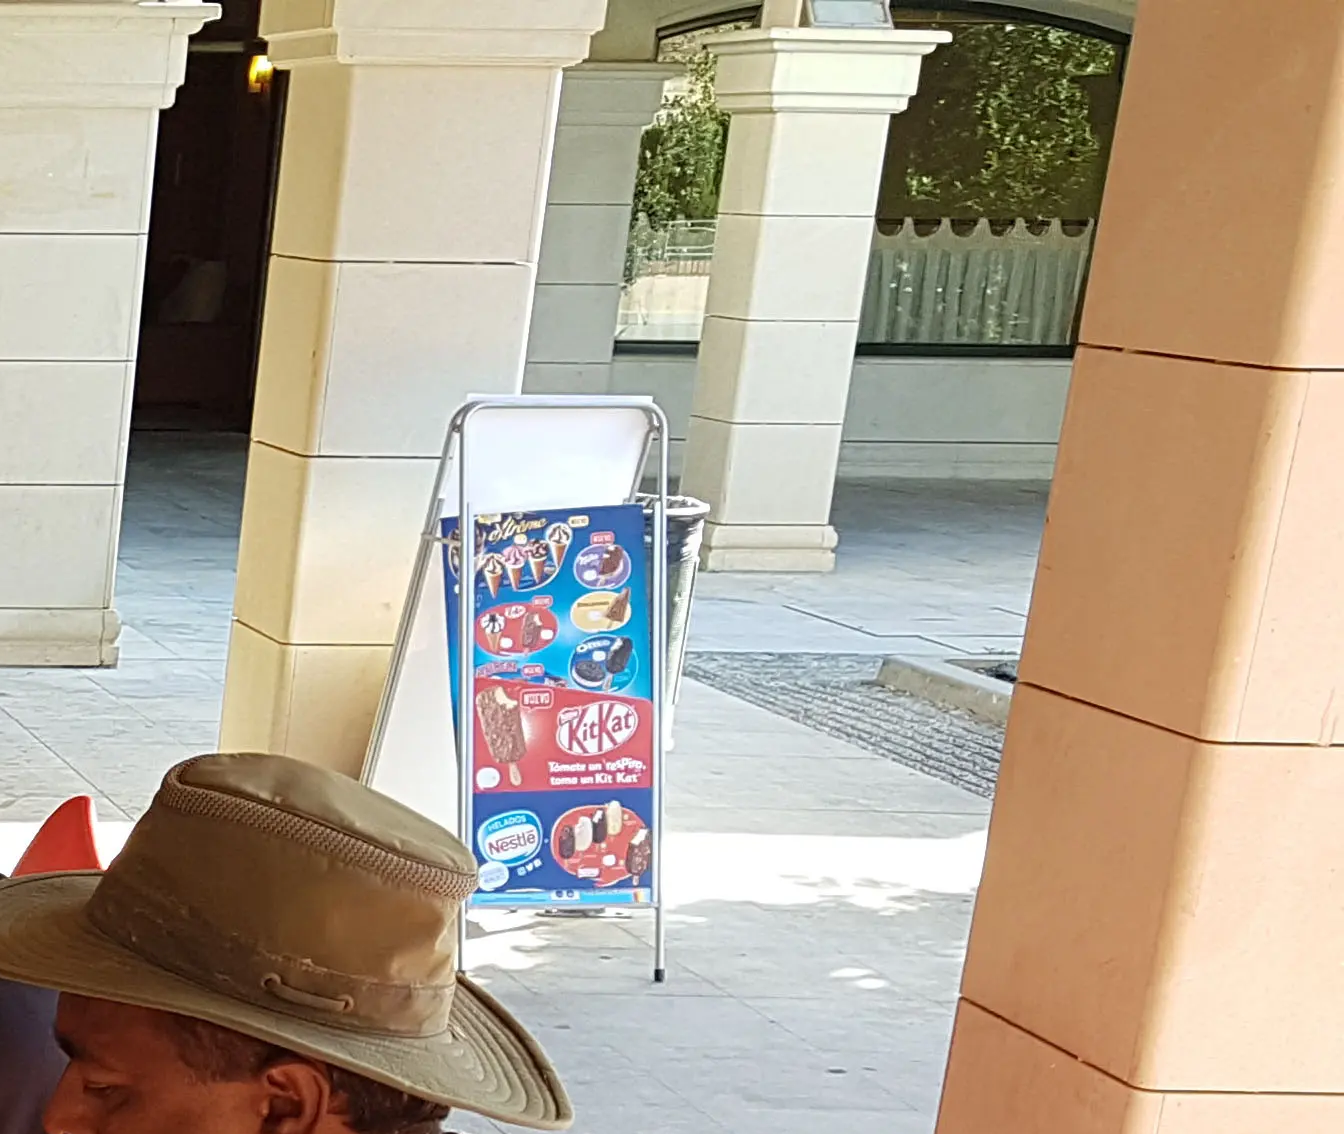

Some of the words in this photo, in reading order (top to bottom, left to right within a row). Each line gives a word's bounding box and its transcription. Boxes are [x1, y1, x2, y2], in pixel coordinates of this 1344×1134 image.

[523, 693, 550, 705] NUEVO
[595, 773, 613, 784] Kit
[488, 814, 527, 832] HELADOS
